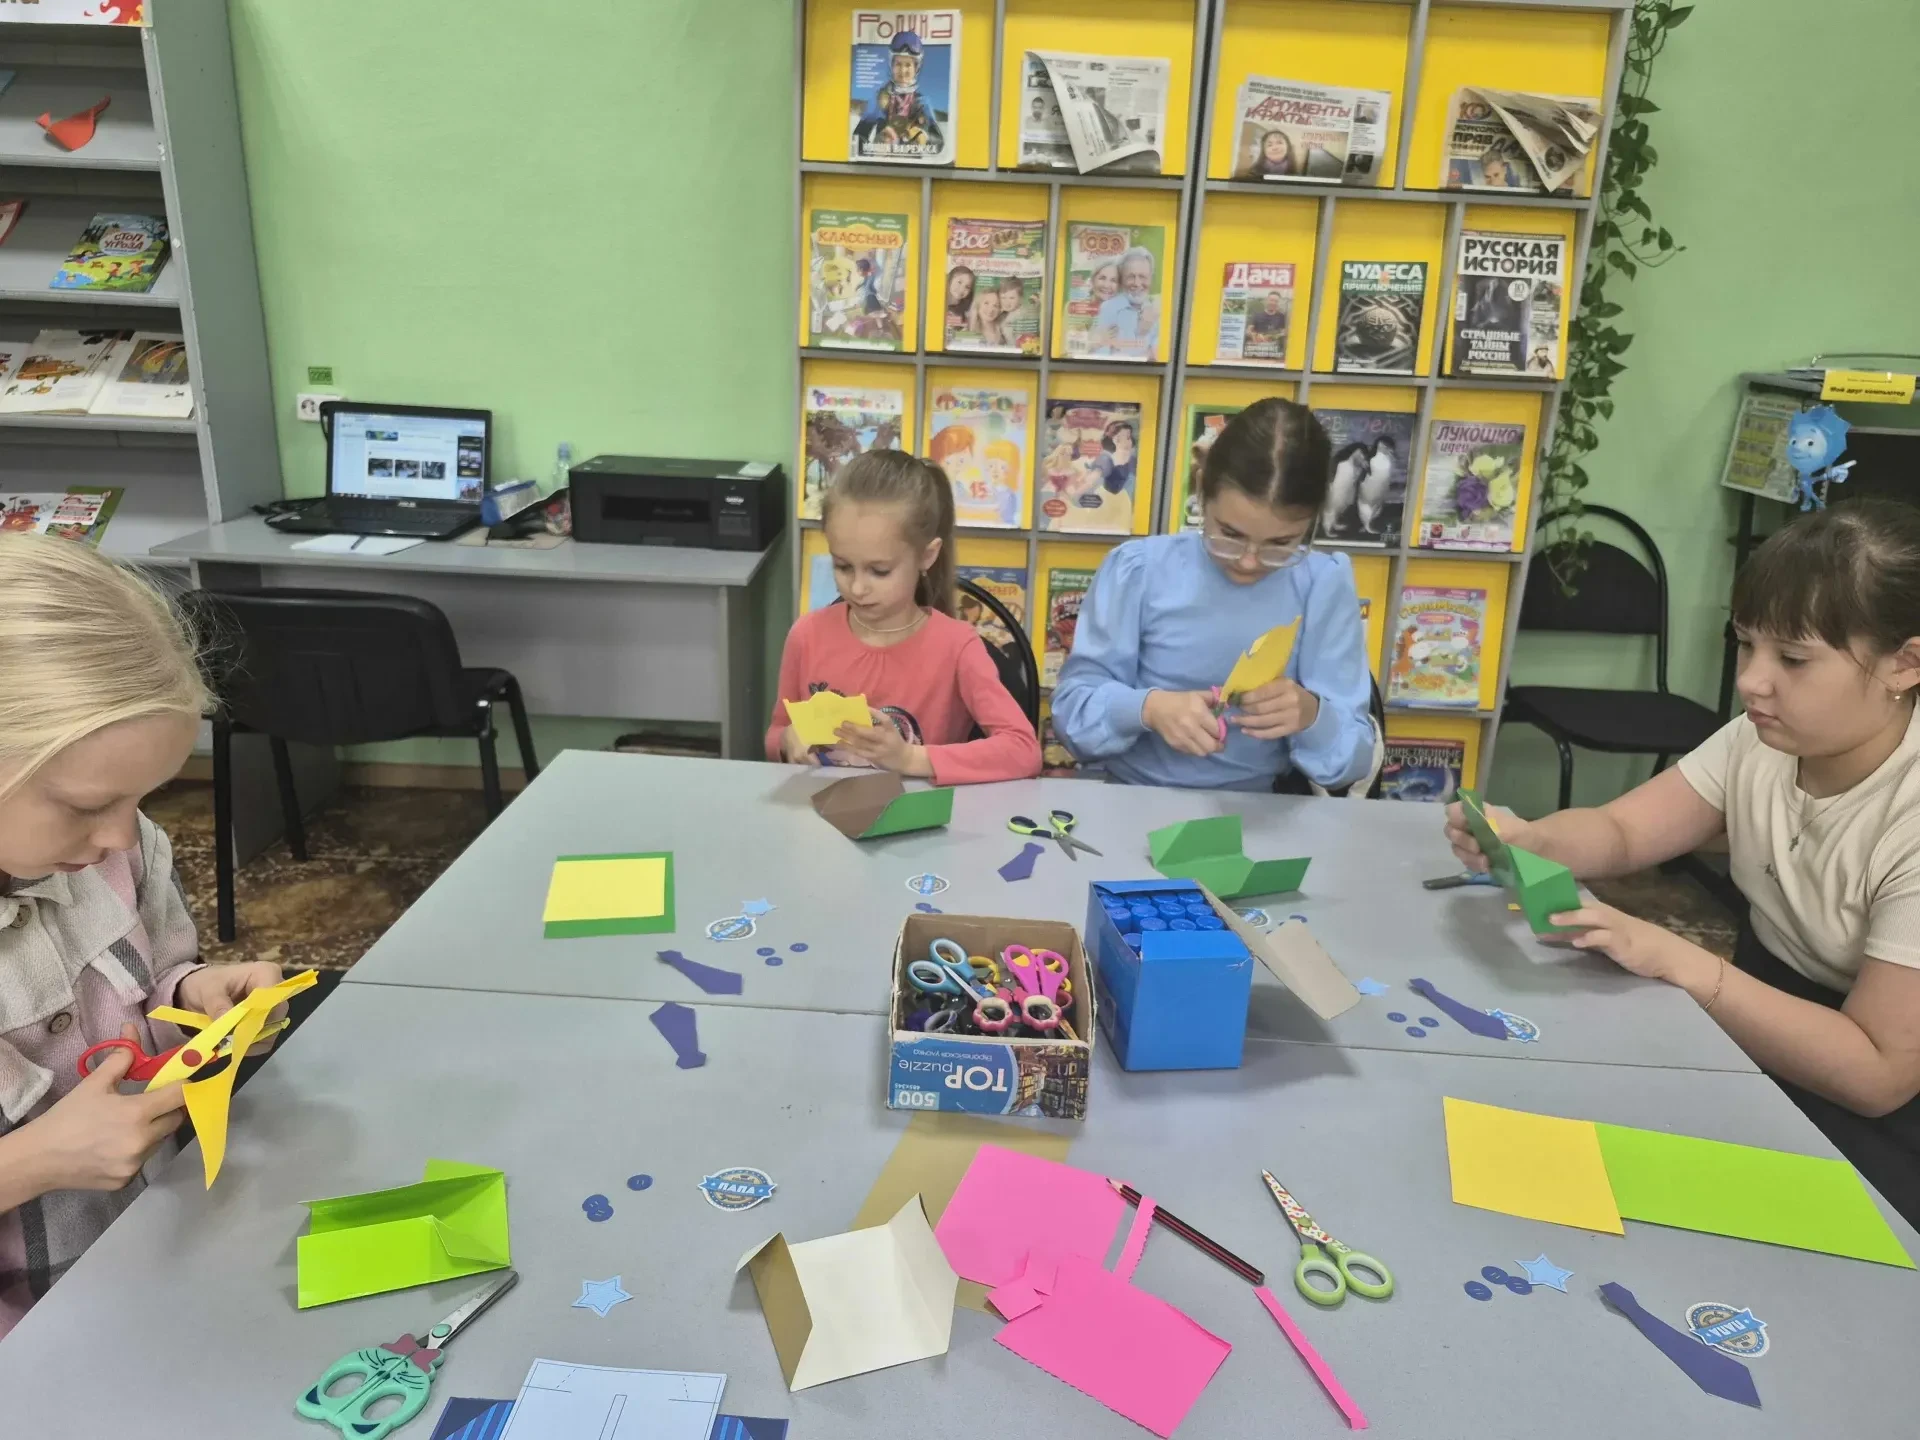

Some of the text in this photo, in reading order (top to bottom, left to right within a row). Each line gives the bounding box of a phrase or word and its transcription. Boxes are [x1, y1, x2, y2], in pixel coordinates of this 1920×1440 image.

[1252, 96, 1352, 118] АРГУМЕНТЫ
[820, 231, 900, 247] КЛАССНЫЙ
[1464, 238, 1559, 259] РУССКАЯ
[1344, 263, 1423, 280] ЧУДЕСА
[1463, 256, 1558, 276] ИСТОРИЯ
[1228, 264, 1290, 288] Дача
[1460, 329, 1521, 342] СТРАШНЫЕ
[1470, 340, 1511, 351] ТАЙНЫ
[1468, 350, 1512, 361] РОССИИ
[1436, 425, 1519, 444] ЛУКОШКО
[898, 1059, 1008, 1092] TOP puzzle
[899, 1090, 938, 1106] 500
[718, 1181, 755, 1194] ПАПА
[1708, 1319, 1747, 1338] ПАПА
